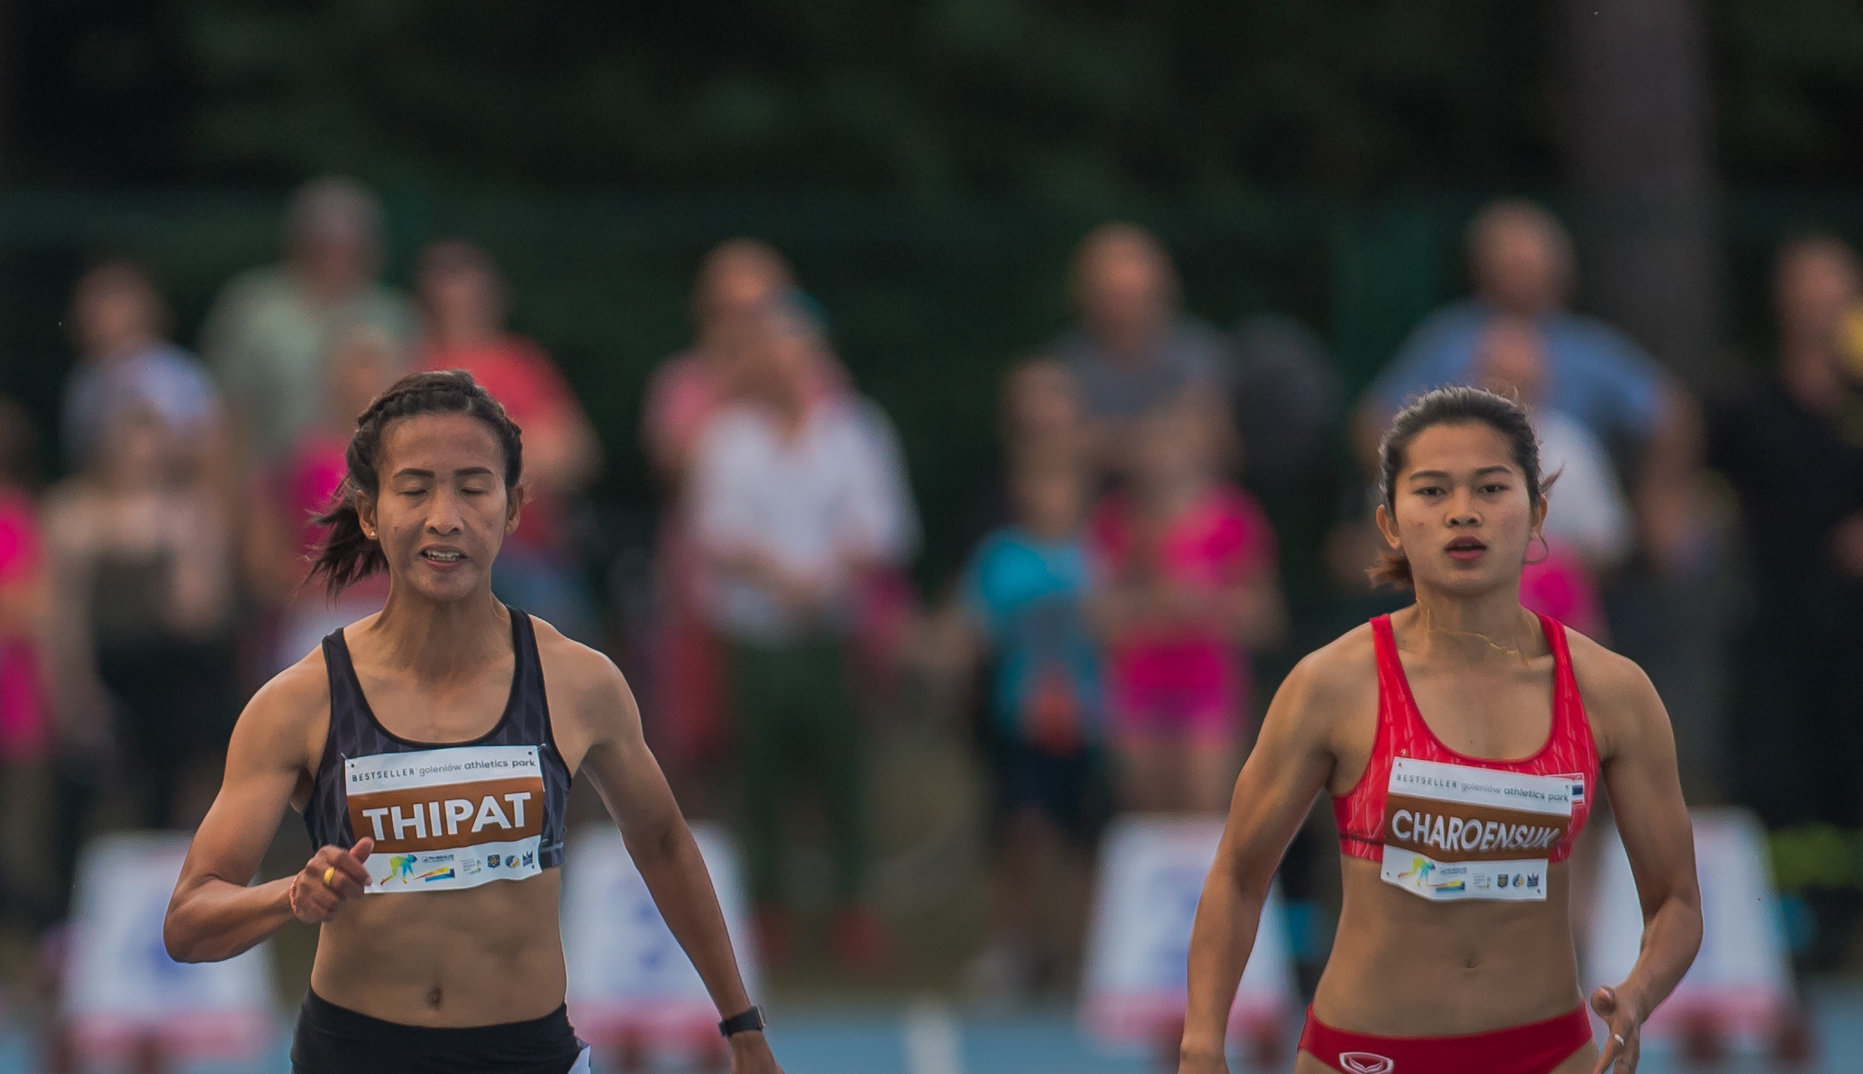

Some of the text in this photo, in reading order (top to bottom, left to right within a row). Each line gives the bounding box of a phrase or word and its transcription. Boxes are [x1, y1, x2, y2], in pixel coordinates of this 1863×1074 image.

[352, 758, 536, 782] BESTSELLER goleniów athletics park
[1396, 773, 1457, 788] BESTSELLER
[1503, 787, 1545, 800] athletics
[1547, 793, 1569, 802] park
[362, 792, 531, 841] THIPAT
[1391, 809, 1560, 851] CHAROENSUK
